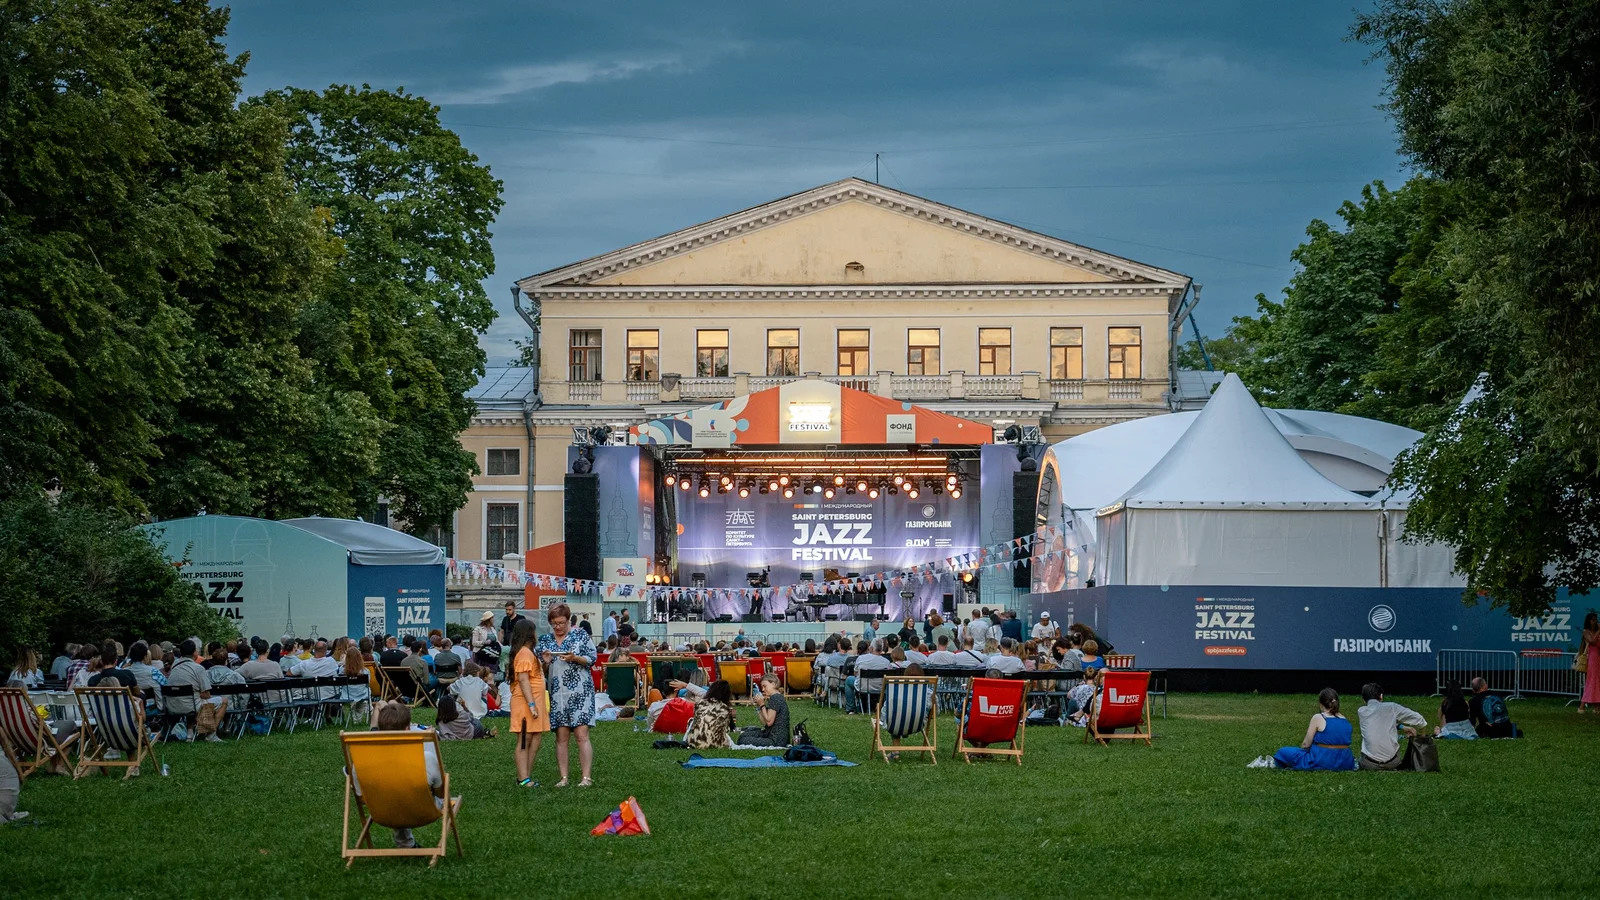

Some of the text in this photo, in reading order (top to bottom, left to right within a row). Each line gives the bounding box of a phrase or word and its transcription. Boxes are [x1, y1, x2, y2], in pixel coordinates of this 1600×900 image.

[792, 523, 872, 545] JAZZ
[792, 548, 872, 560] FESTIVAL
[193, 581, 243, 603] AZZ
[397, 606, 430, 625] JAZZ
[1195, 612, 1255, 628] JAZZ
[1511, 614, 1571, 630] JAZZ
[1195, 631, 1255, 640] FESTIVAL
[1511, 633, 1571, 642] FESTIVAL
[1334, 639, 1432, 652] ГАЗПРОМБАНК
